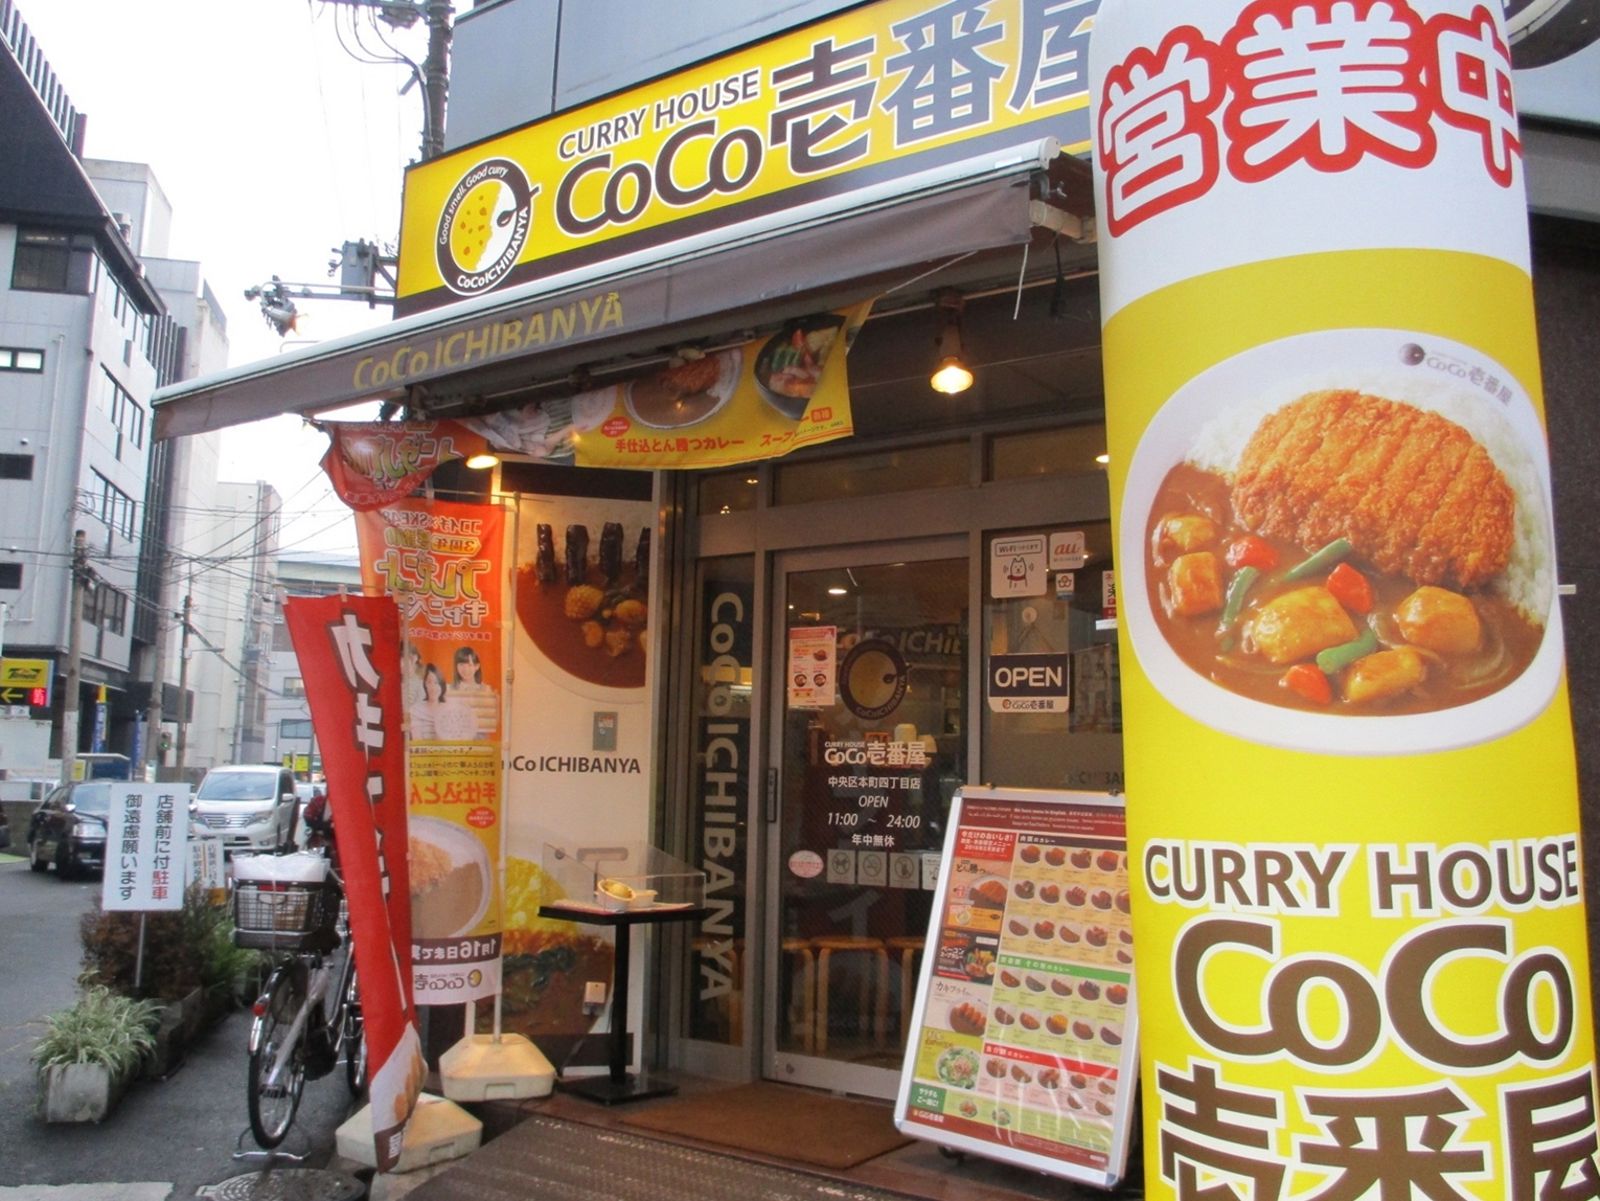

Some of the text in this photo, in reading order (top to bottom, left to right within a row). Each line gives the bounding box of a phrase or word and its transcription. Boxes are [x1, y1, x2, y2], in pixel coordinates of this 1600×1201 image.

[559, 69, 760, 160] CURRY HOUSE
[1101, 0, 1524, 238] 営業中
[994, 666, 1063, 688] OPEN
[824, 740, 927, 766] CoCo壱番屋
[828, 775, 921, 790] 中央区本町四丁目店
[858, 795, 889, 808] OPEN
[827, 812, 859, 826] 11:00
[886, 814, 921, 829] 24:00
[851, 834, 896, 848] 年中無休
[118, 793, 143, 901] 御遠慮願います
[151, 794, 175, 902] 店舗前に付駐車
[1143, 834, 1579, 913] CURRY HOUSE
[1173, 917, 1576, 1070] CoCo
